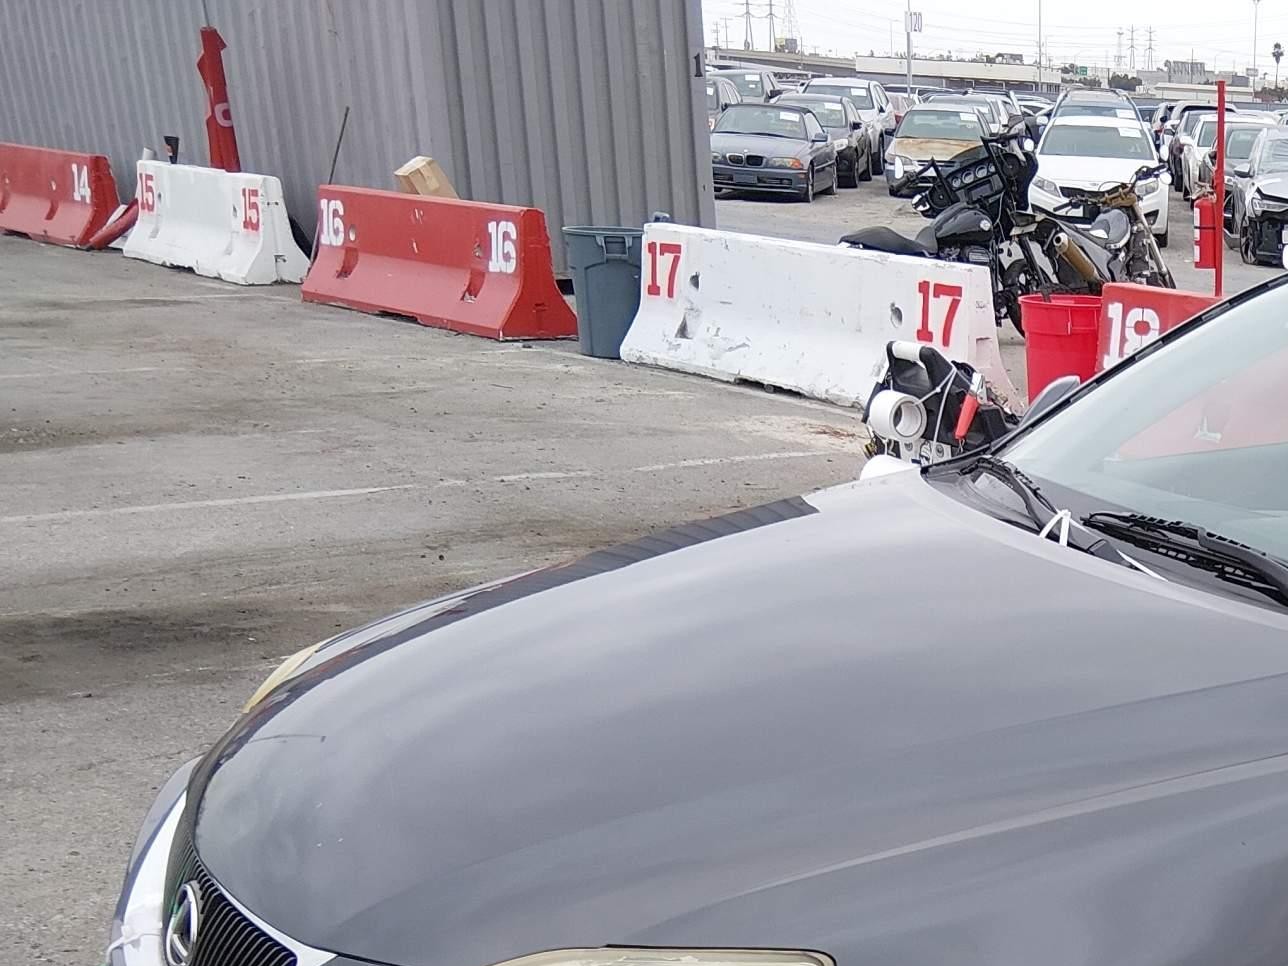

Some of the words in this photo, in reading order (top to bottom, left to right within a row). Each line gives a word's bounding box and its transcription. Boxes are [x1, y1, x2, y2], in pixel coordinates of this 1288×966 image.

[71, 163, 91, 204] 14
[138, 173, 155, 213] 15
[241, 188, 260, 232] 15
[320, 198, 345, 246] 16
[487, 221, 517, 273] 16
[646, 241, 682, 298] 17
[916, 280, 962, 347] 17
[1103, 302, 1160, 367] 18
